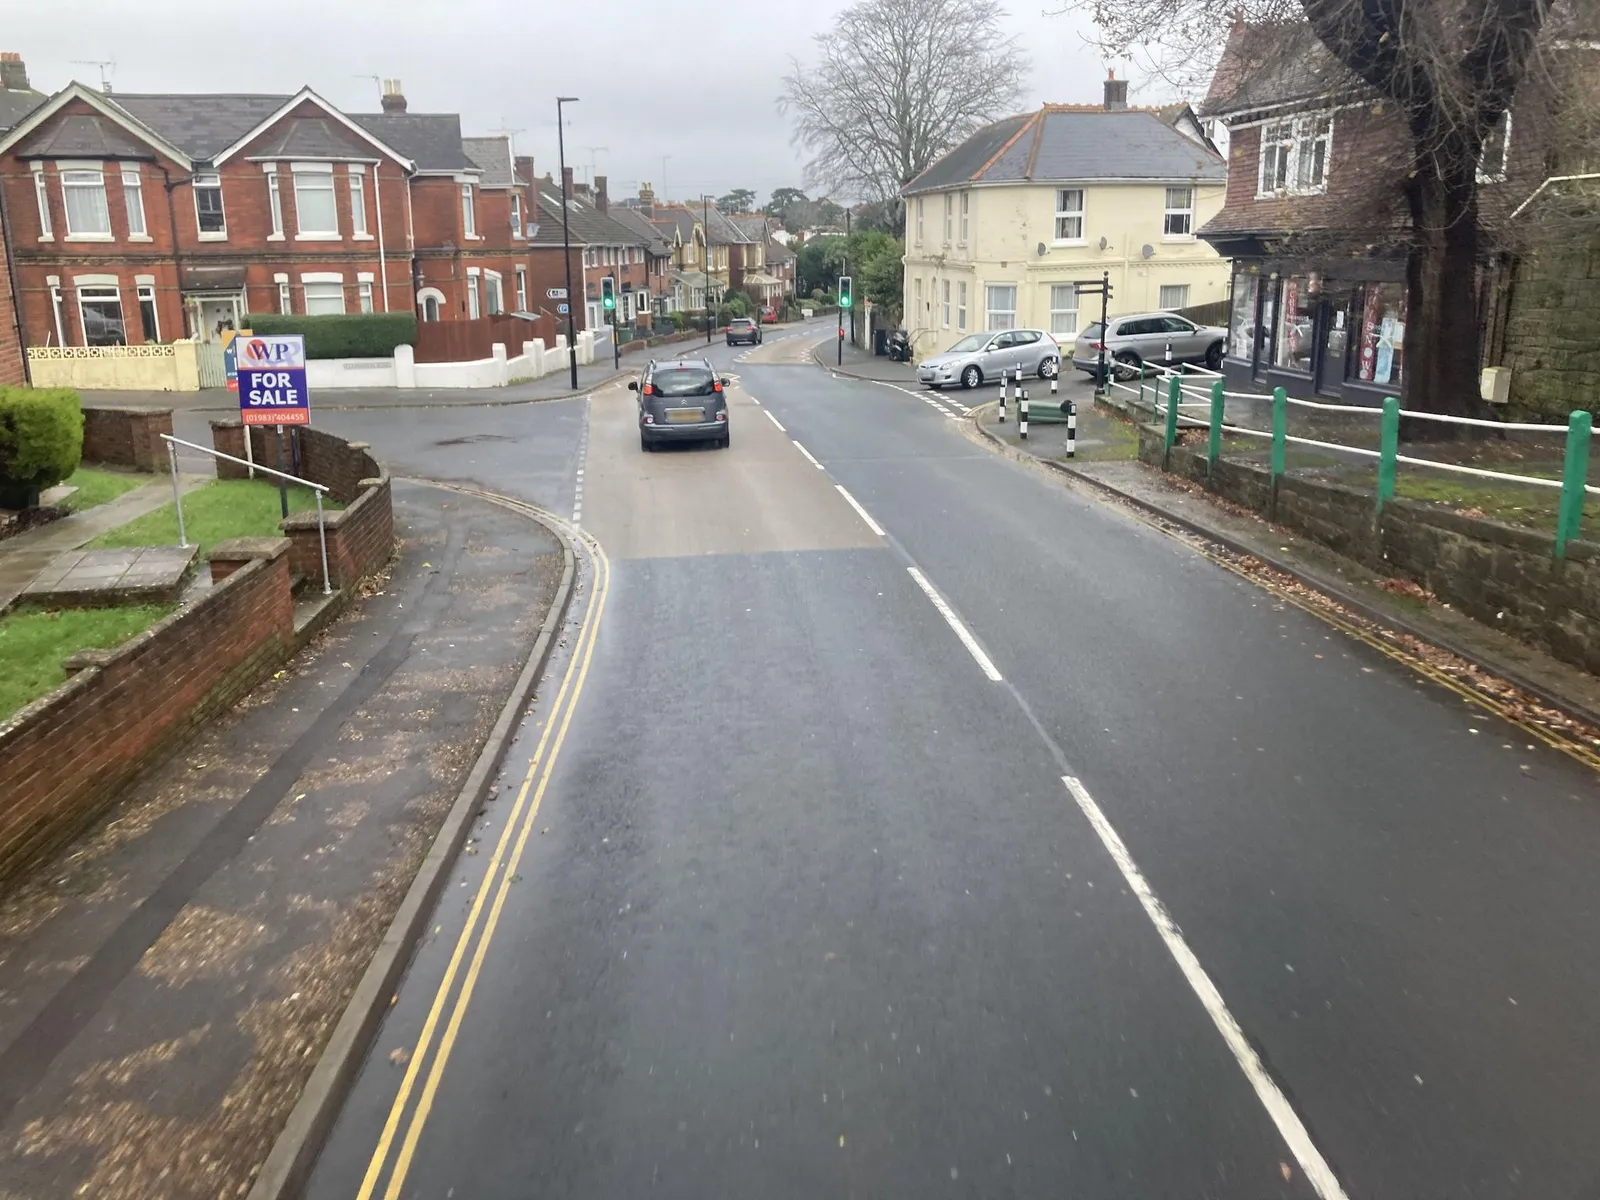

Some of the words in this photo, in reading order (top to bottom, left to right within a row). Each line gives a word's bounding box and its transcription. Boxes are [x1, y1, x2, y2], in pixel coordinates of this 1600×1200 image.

[250, 343, 289, 360] WP
[251, 372, 292, 388] FOR
[249, 389, 298, 405] SALE
